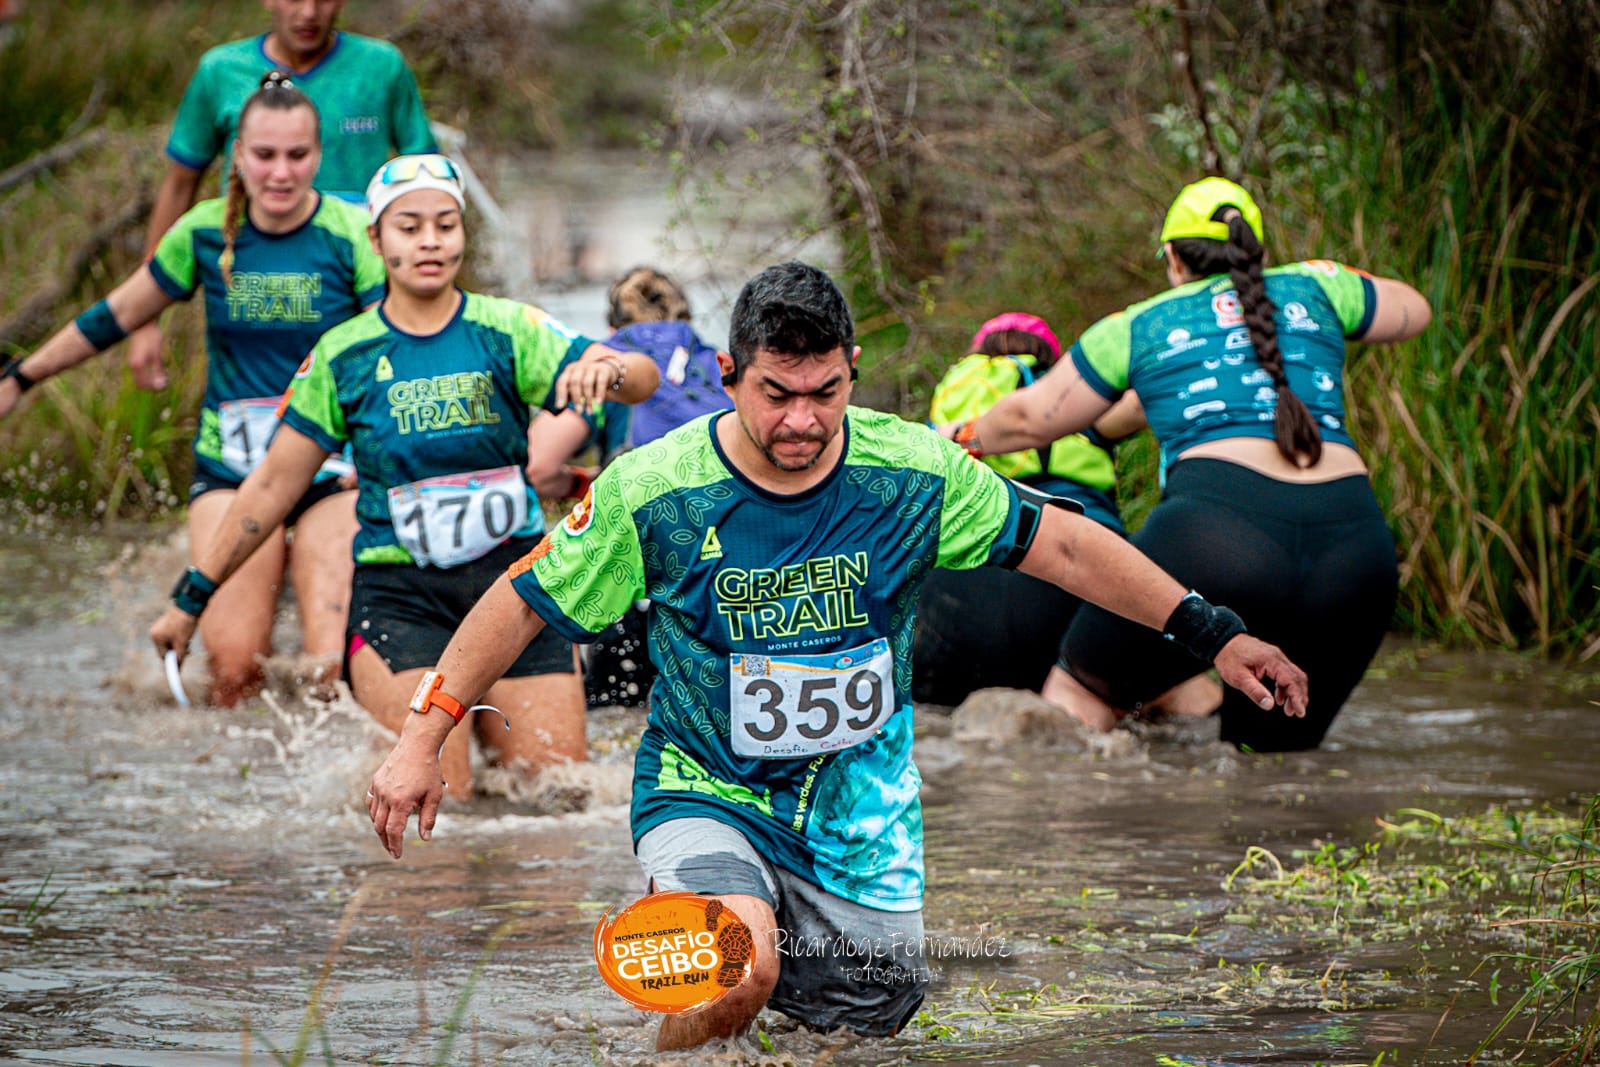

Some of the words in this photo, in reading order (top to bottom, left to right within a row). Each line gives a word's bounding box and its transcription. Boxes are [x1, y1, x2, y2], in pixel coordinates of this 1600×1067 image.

[229, 271, 322, 298] GREEN
[225, 294, 322, 322] TRAIL
[387, 370, 495, 407] GREEN
[390, 395, 500, 434] TRAIL
[404, 489, 515, 554] 170
[714, 551, 869, 601] GREEN
[717, 589, 869, 641] TRAIL
[767, 640, 799, 651] MONTE
[802, 635, 842, 648] CASEROS
[743, 669, 883, 742] 359
